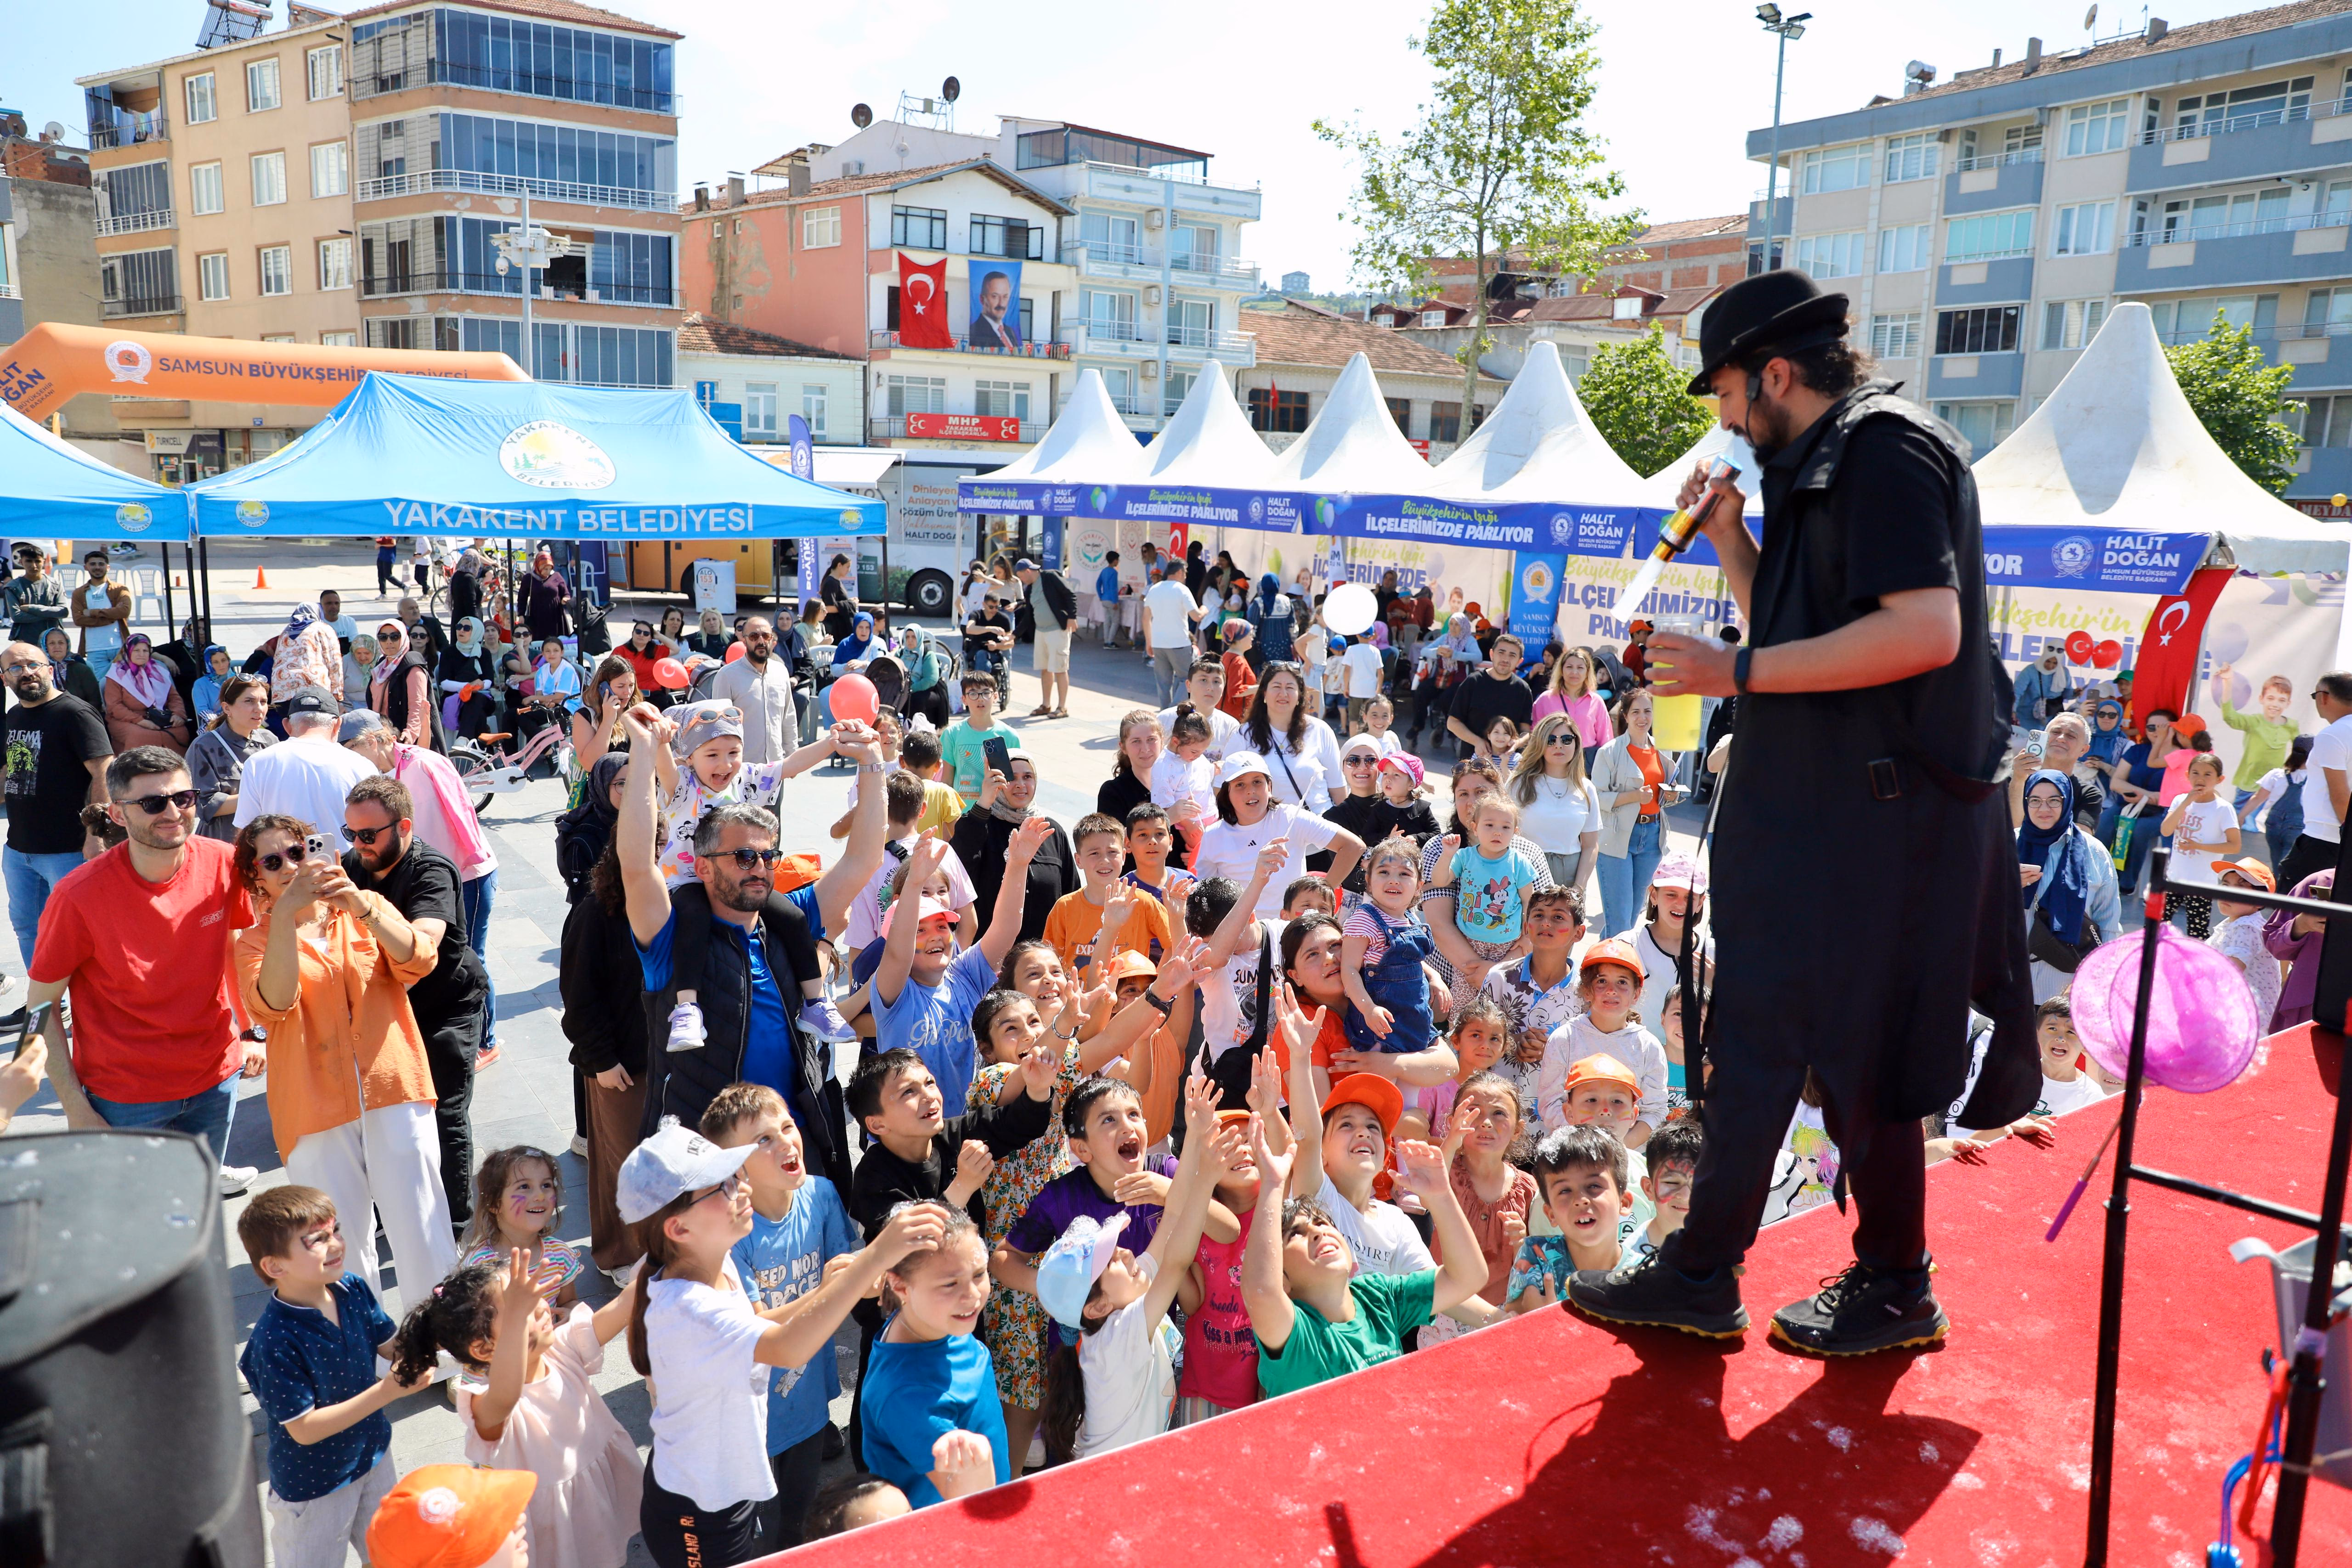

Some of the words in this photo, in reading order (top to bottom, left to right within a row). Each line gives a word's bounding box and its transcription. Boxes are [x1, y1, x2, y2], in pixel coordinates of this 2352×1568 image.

[0, 361, 23, 389] LİT
[159, 357, 243, 376] SAMSUN
[249, 362, 368, 384] BÜYÜKŞEHİR
[18, 382, 54, 410] BÜYÜKŞEHİR
[31, 390, 56, 410] BAŞKANI
[948, 417, 980, 426] MHP
[156, 437, 182, 446] TURKCELL
[506, 422, 597, 450] YAKAKENT
[908, 496, 950, 507] Anlayan
[958, 496, 1001, 510] İLÇELERİMİZDE
[1002, 498, 1035, 511] PARLIYOR
[1054, 495, 1076, 504] DOĞAN
[1268, 496, 1290, 507] HALİT
[384, 501, 567, 530] YAKAKENT
[578, 502, 754, 532] BELEDİYESİ
[900, 508, 934, 518] Çözüm
[937, 507, 971, 518] Üretn
[1125, 500, 1189, 518] İLÇELERİMİZDE
[1190, 506, 1239, 522] PARLIYOR
[1267, 505, 1296, 517] DOĞAN
[1580, 513, 1616, 525] HALİT
[905, 530, 930, 539] HALİT
[1365, 513, 1465, 538] İLÇELERİMİZDE
[1464, 525, 1533, 543] PARLIYOR
[1578, 524, 1623, 538] DOĞAN
[1316, 535, 1397, 561] Behir'in
[2105, 536, 2169, 551] HALİT
[2103, 550, 2180, 568] DOĞAN
[1312, 553, 1428, 588] İLÇERİMZDE
[1565, 554, 1689, 589] Büyükşr'in
[2131, 569, 2177, 578] BÜYÜKŞEHİR
[1559, 577, 1736, 624] İLÇELRİMİZDE
[1989, 599, 2133, 635] ükşehir'in
[1513, 624, 1553, 635] BÜYÜKŞEH
[1521, 636, 1551, 645] ELEDİYE
[6, 729, 41, 749] ZEUGMA
[1075, 944, 1122, 957] EXPRE
[1233, 964, 1285, 983] SUMR
[908, 1018, 941, 1049] Girl
[942, 1018, 972, 1047] Pow
[792, 1250, 820, 1280] MOR
[1232, 1314, 1251, 1329] the
[1224, 1330, 1232, 1344] a
[1233, 1326, 1257, 1347] mag
[684, 1533, 702, 1568] SLAND
